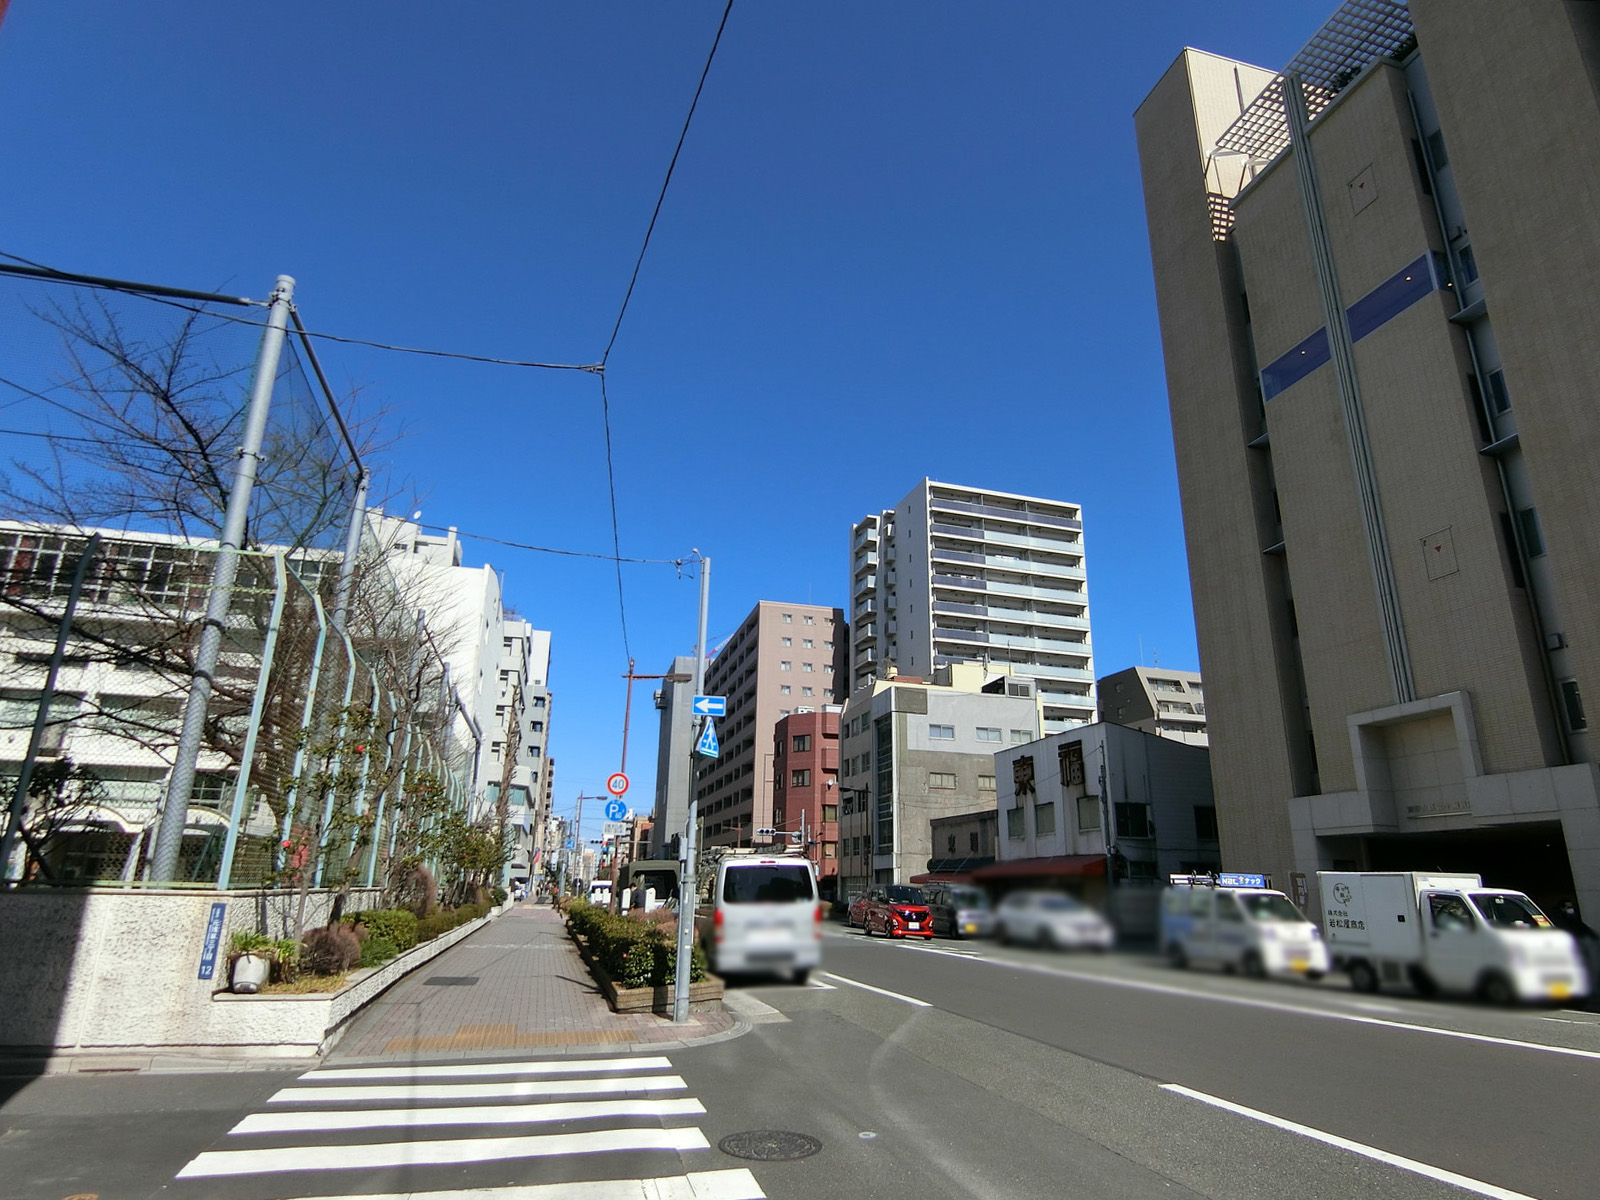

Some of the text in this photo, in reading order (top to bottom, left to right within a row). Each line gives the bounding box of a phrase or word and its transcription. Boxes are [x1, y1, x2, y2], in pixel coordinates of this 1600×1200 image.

[612, 779, 625, 789] 40
[609, 804, 619, 819] P
[201, 965, 212, 976] 12
